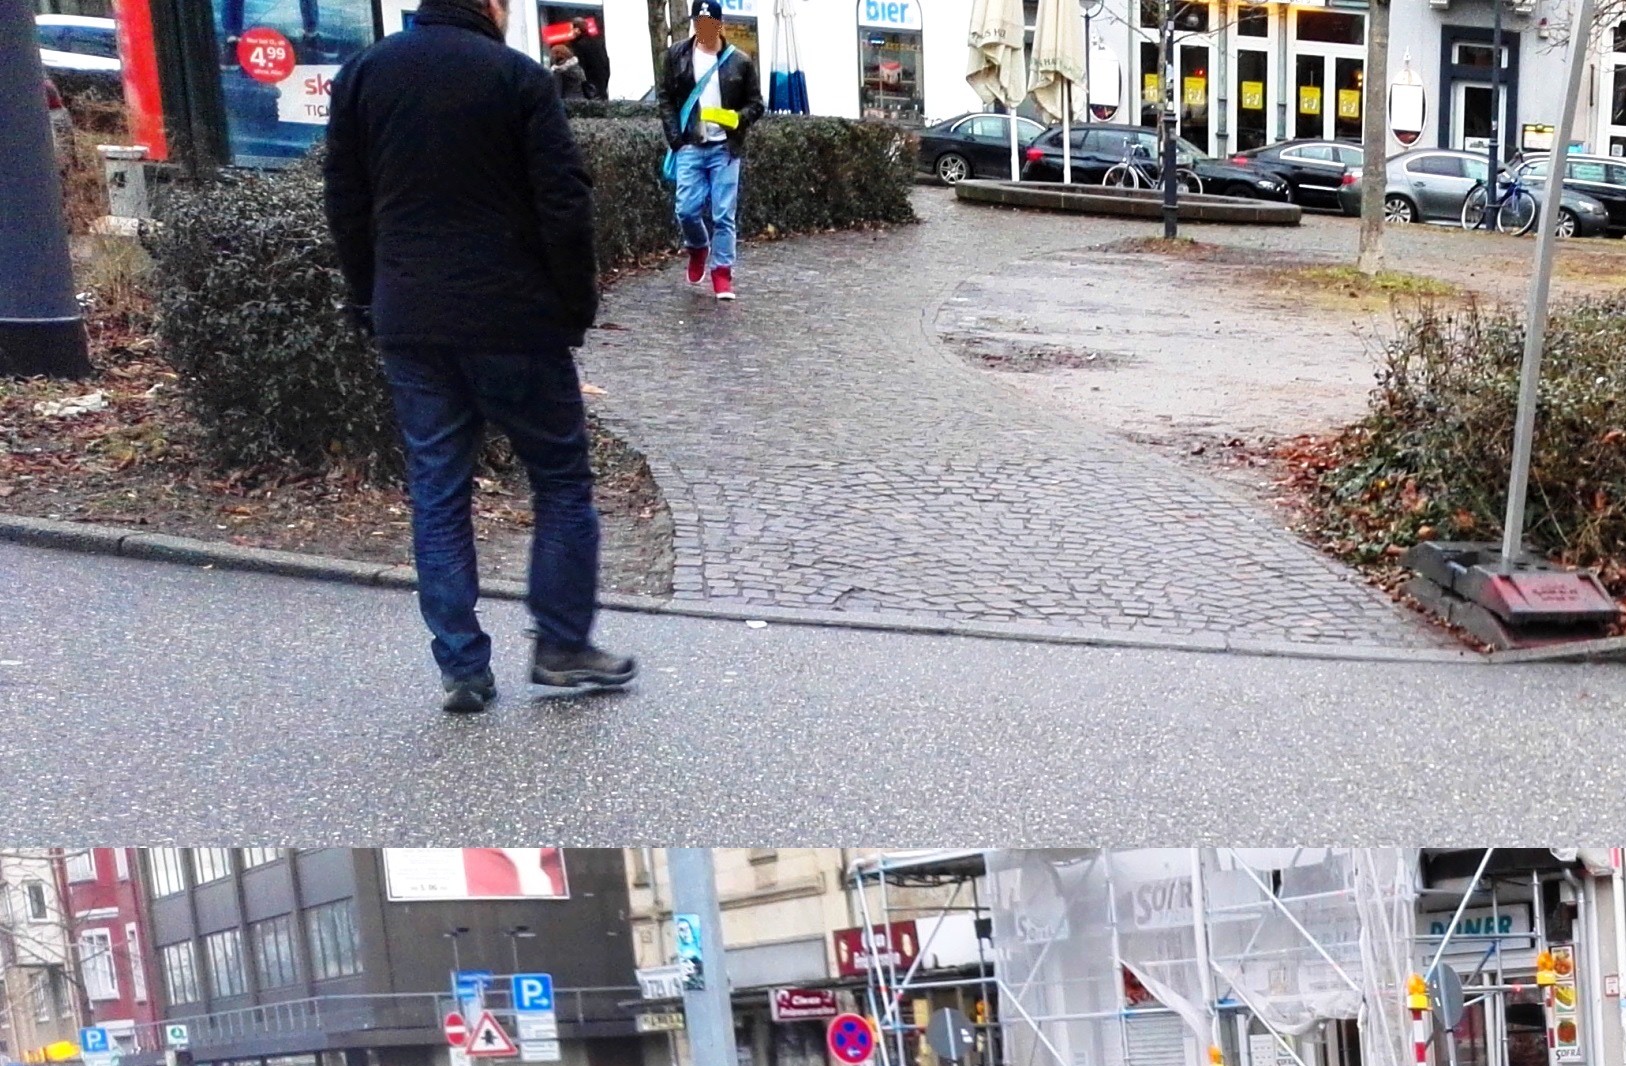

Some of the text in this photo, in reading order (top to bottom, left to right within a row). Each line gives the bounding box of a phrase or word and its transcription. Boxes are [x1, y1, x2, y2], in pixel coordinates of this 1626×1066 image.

[866, 0, 908, 23] bier
[249, 46, 286, 68] 4.99
[304, 73, 333, 95] sk
[521, 979, 543, 1007] P
[86, 1031, 101, 1049] P
[1556, 1047, 1582, 1061] SOFRA
